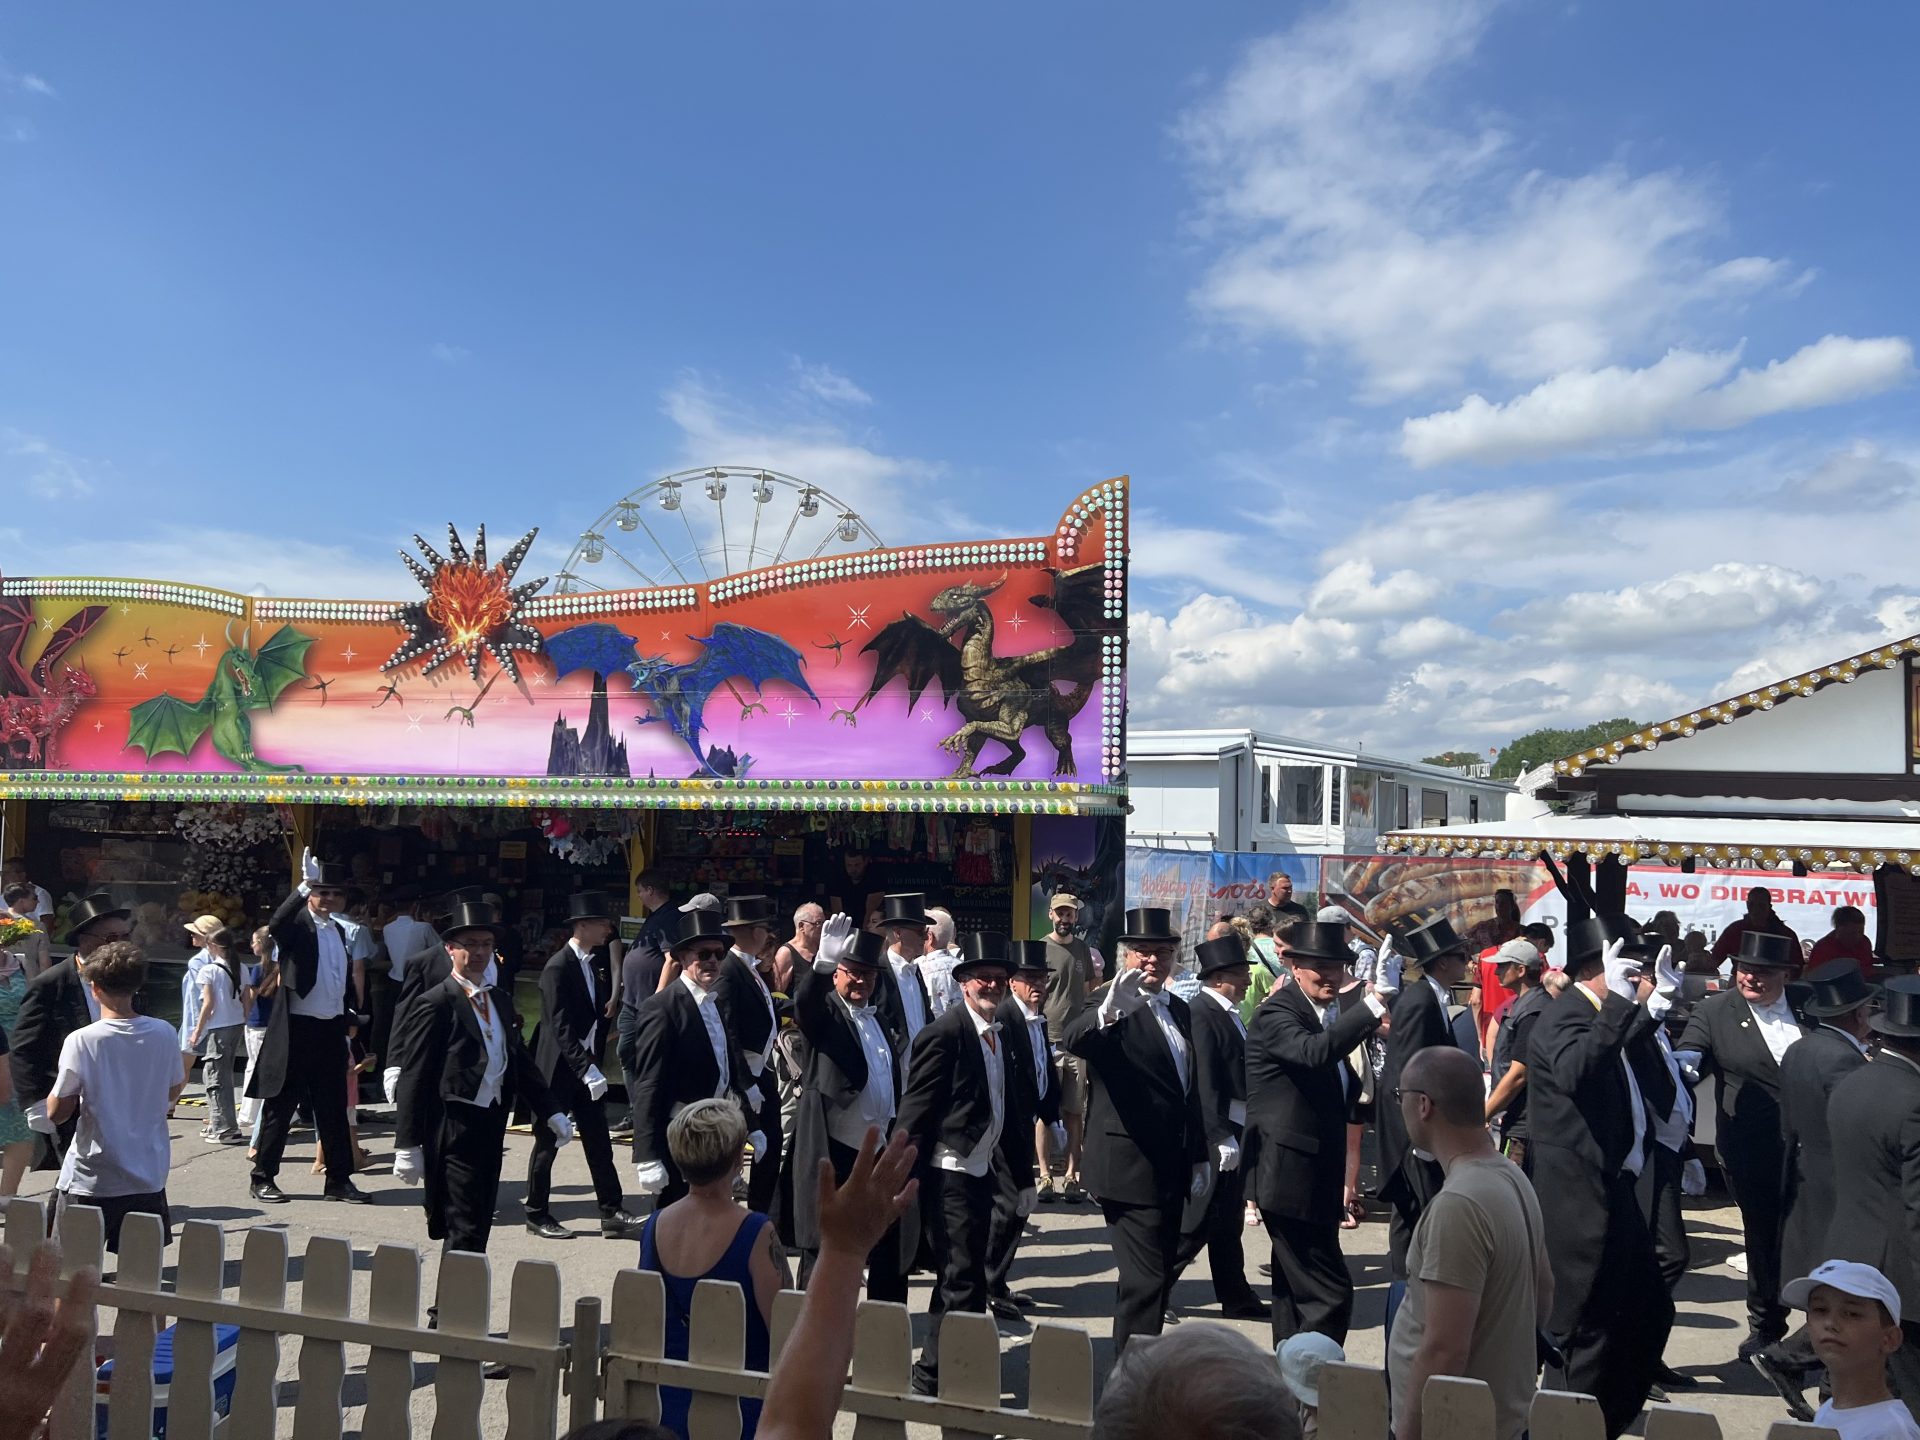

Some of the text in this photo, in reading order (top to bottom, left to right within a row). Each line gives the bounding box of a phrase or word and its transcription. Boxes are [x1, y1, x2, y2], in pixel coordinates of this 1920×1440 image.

[1625, 882, 1649, 900] A,
[1659, 884, 1700, 899] WO
[1711, 886, 1753, 901] DIE
